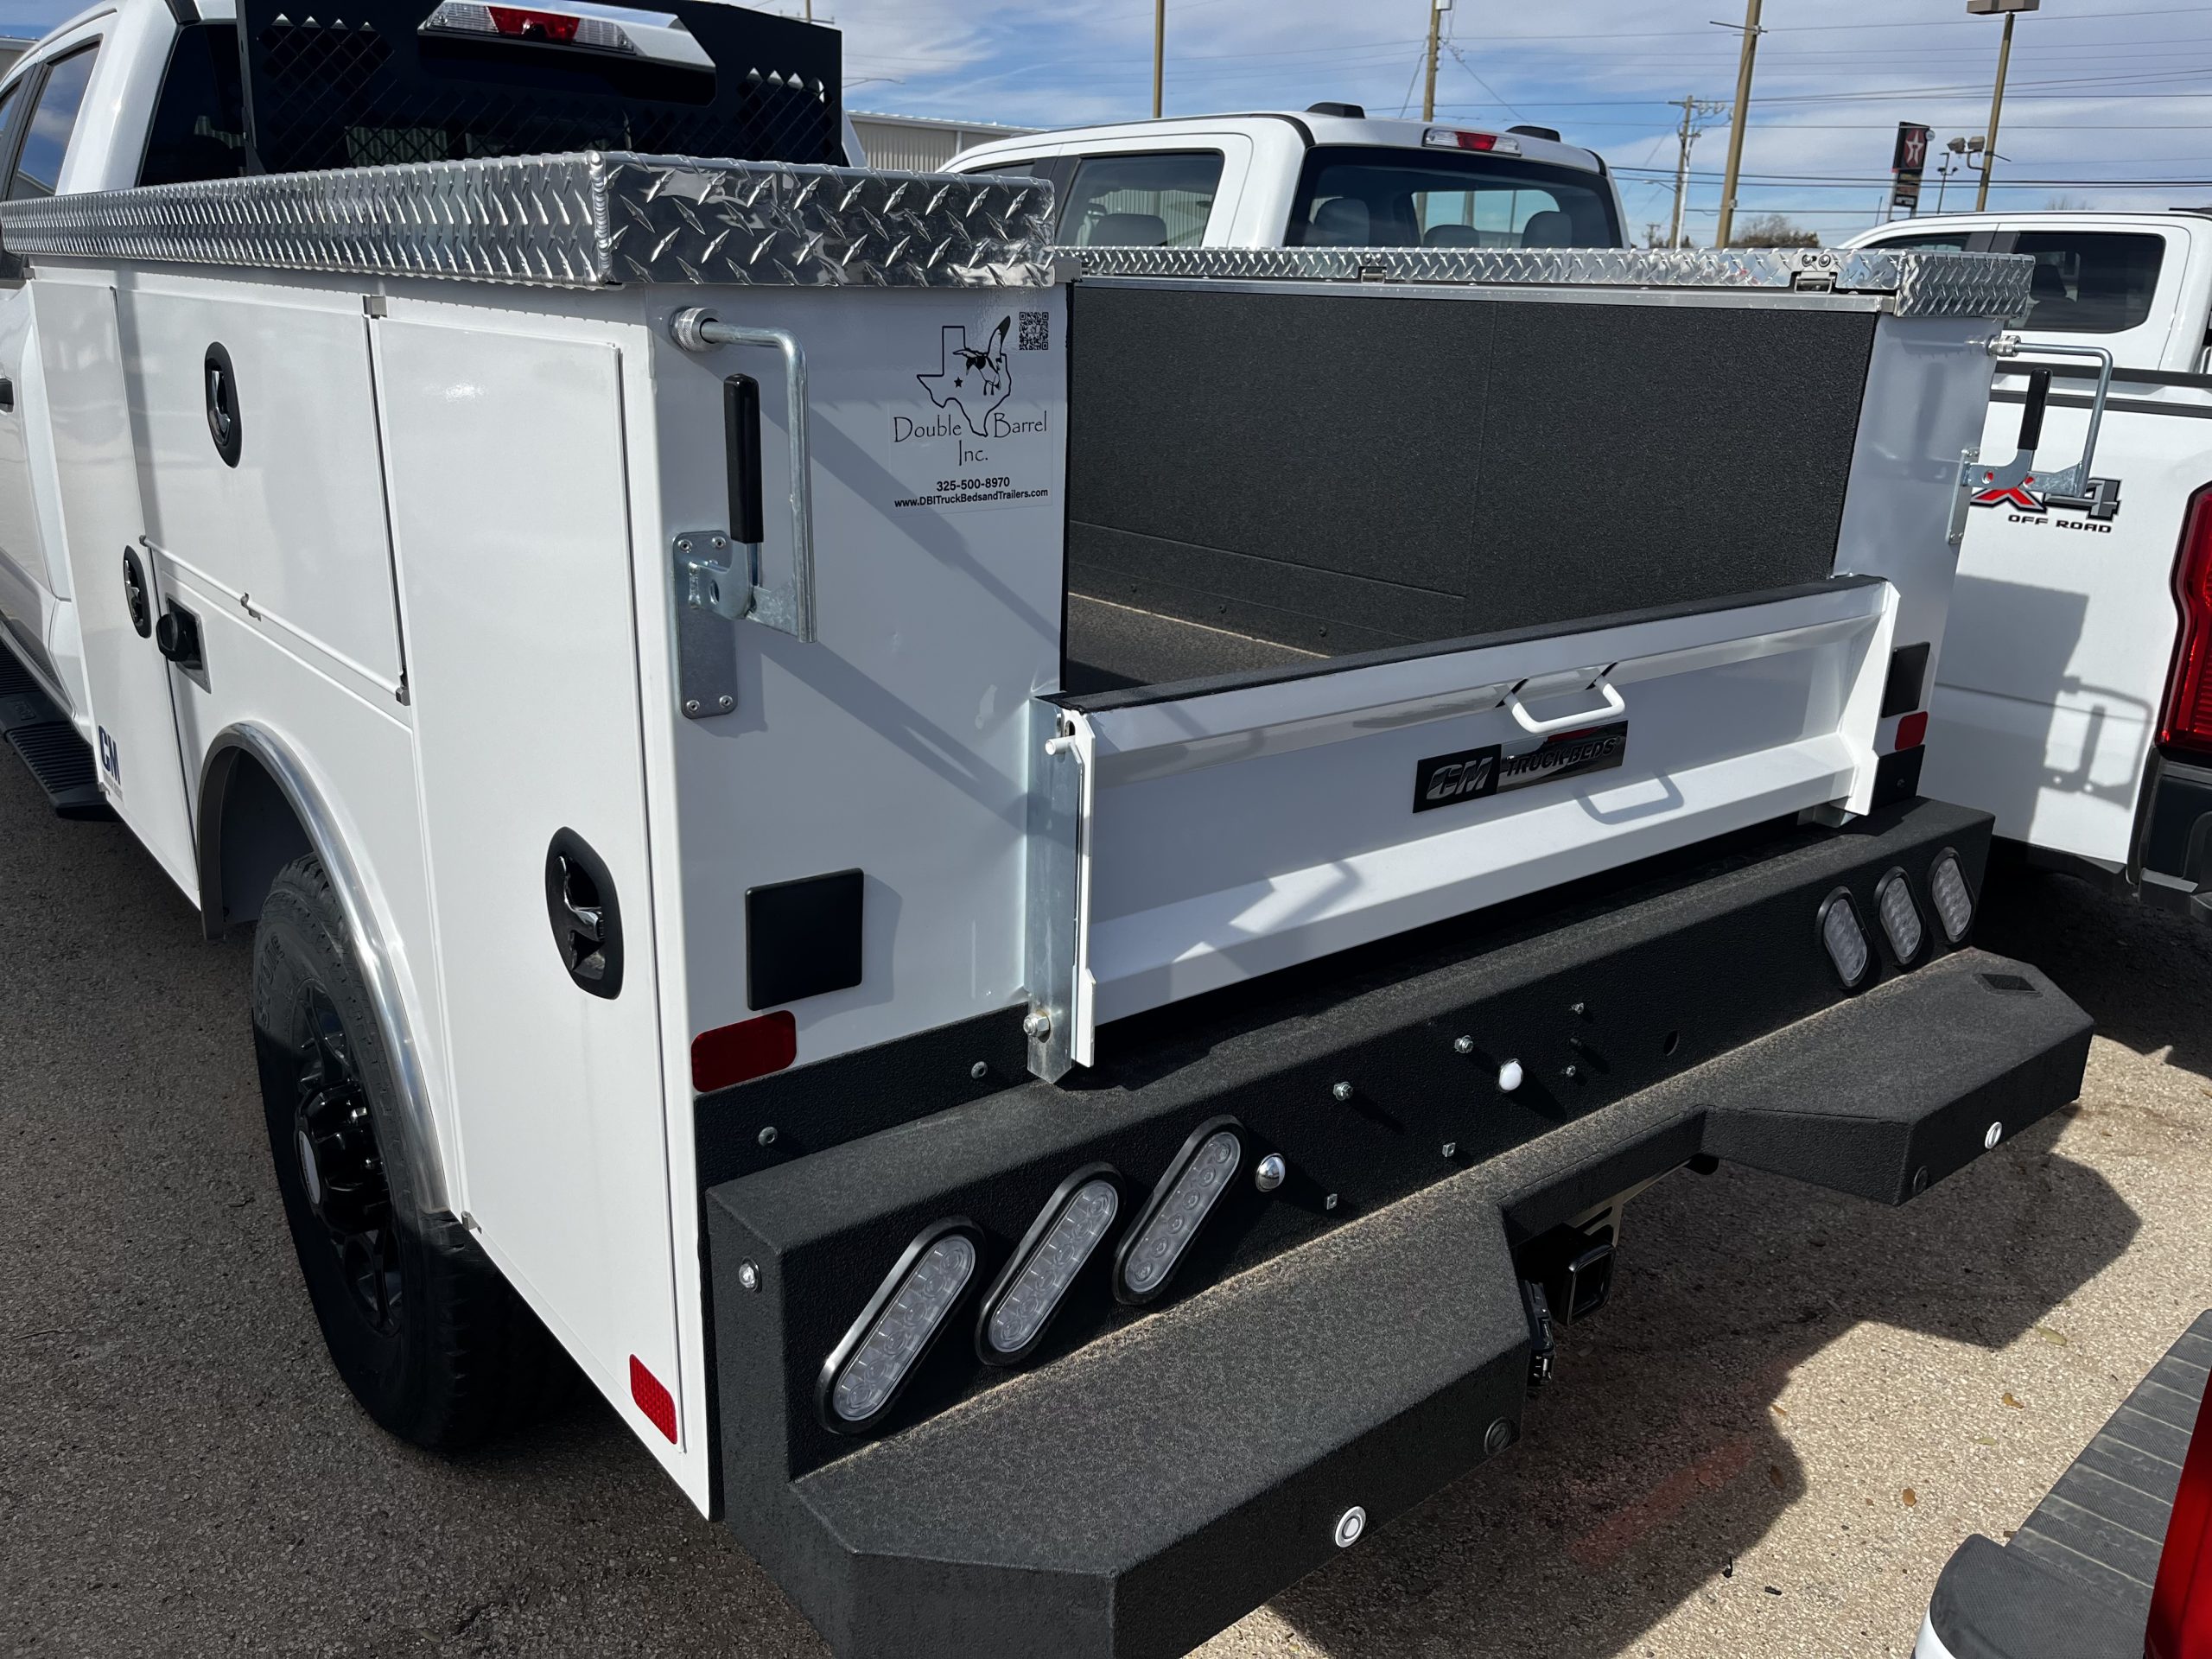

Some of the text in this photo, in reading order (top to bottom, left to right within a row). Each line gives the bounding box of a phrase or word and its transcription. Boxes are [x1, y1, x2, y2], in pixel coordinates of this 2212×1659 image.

[893, 410, 1047, 442] Double Barrel
[959, 440, 988, 466] Inc.
[894, 488, 1048, 507] www.DBITruckBedsandTrailers.com
[937, 477, 1010, 492] 325-500-8970
[2008, 514, 2112, 533] OFF ROAD
[99, 725, 121, 785] CM
[1426, 757, 1493, 800] CM
[1506, 748, 1570, 776] TRUCK
